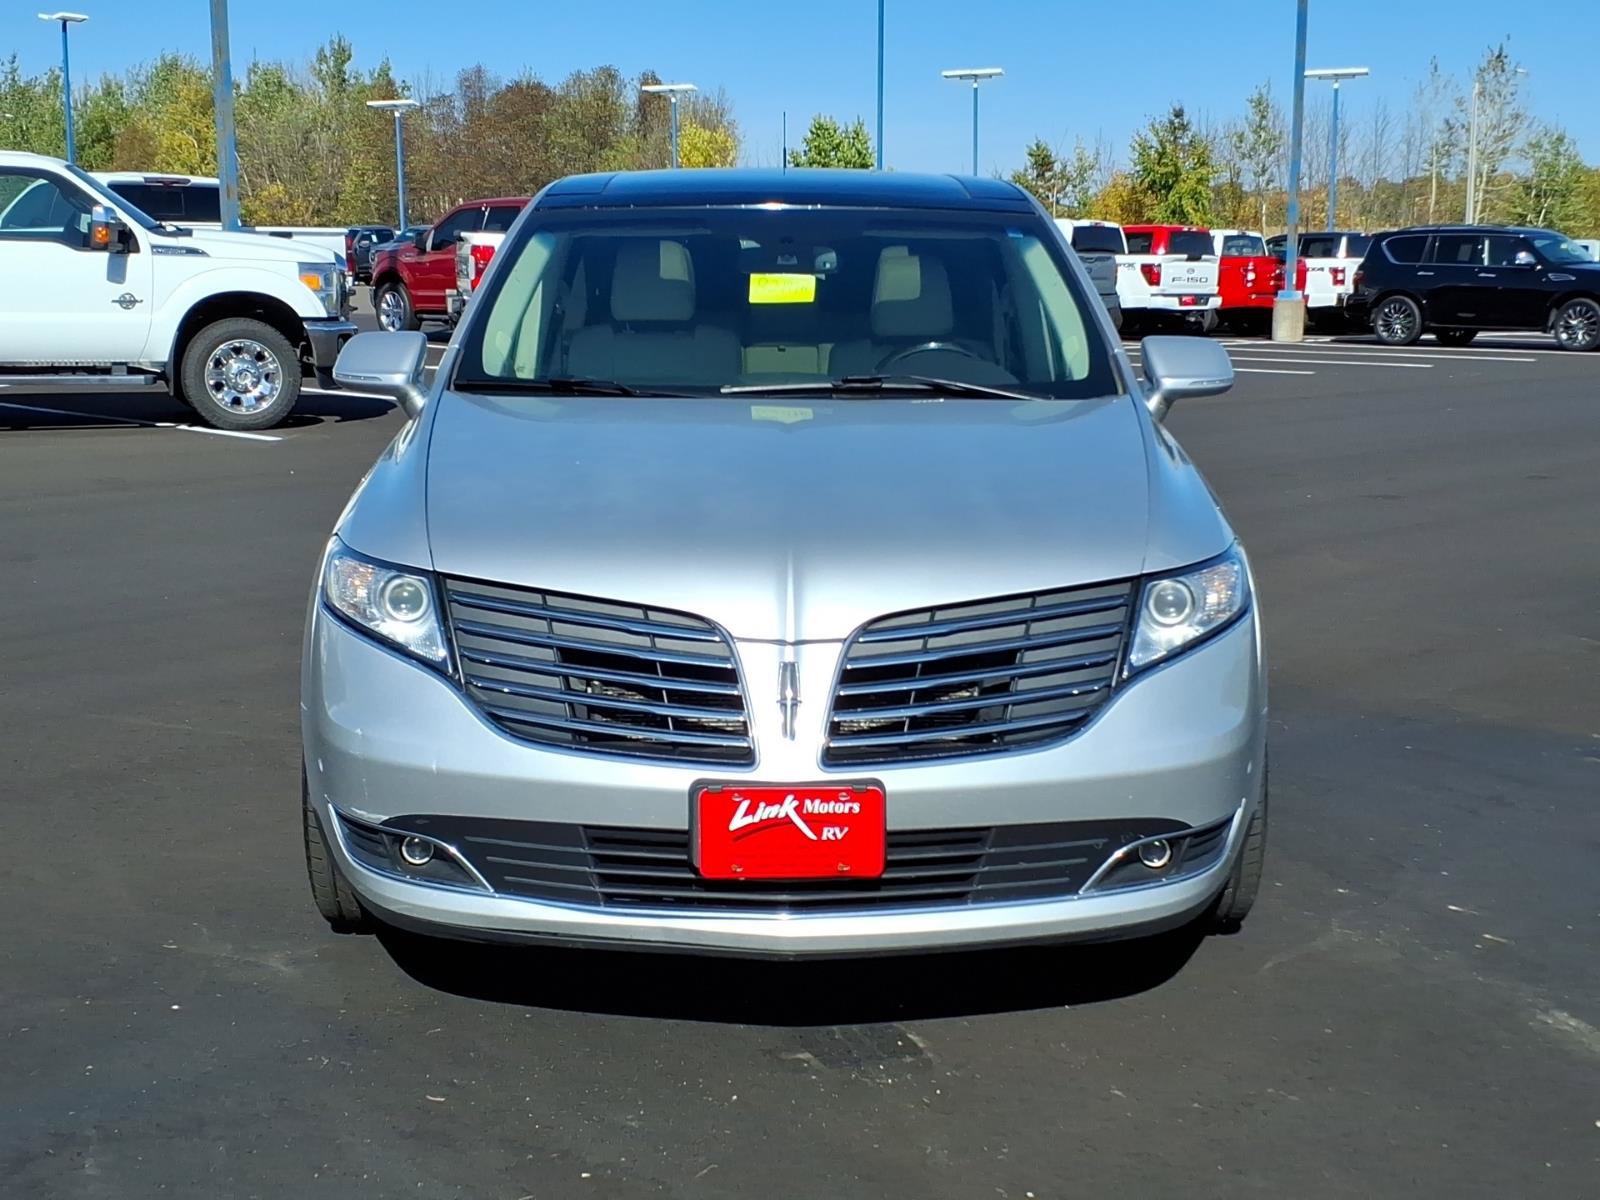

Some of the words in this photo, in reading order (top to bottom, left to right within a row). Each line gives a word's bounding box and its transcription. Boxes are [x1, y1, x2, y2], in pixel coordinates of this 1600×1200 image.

[729, 794, 818, 840] Link
[802, 799, 860, 814] Motors
[821, 827, 848, 840] RV
